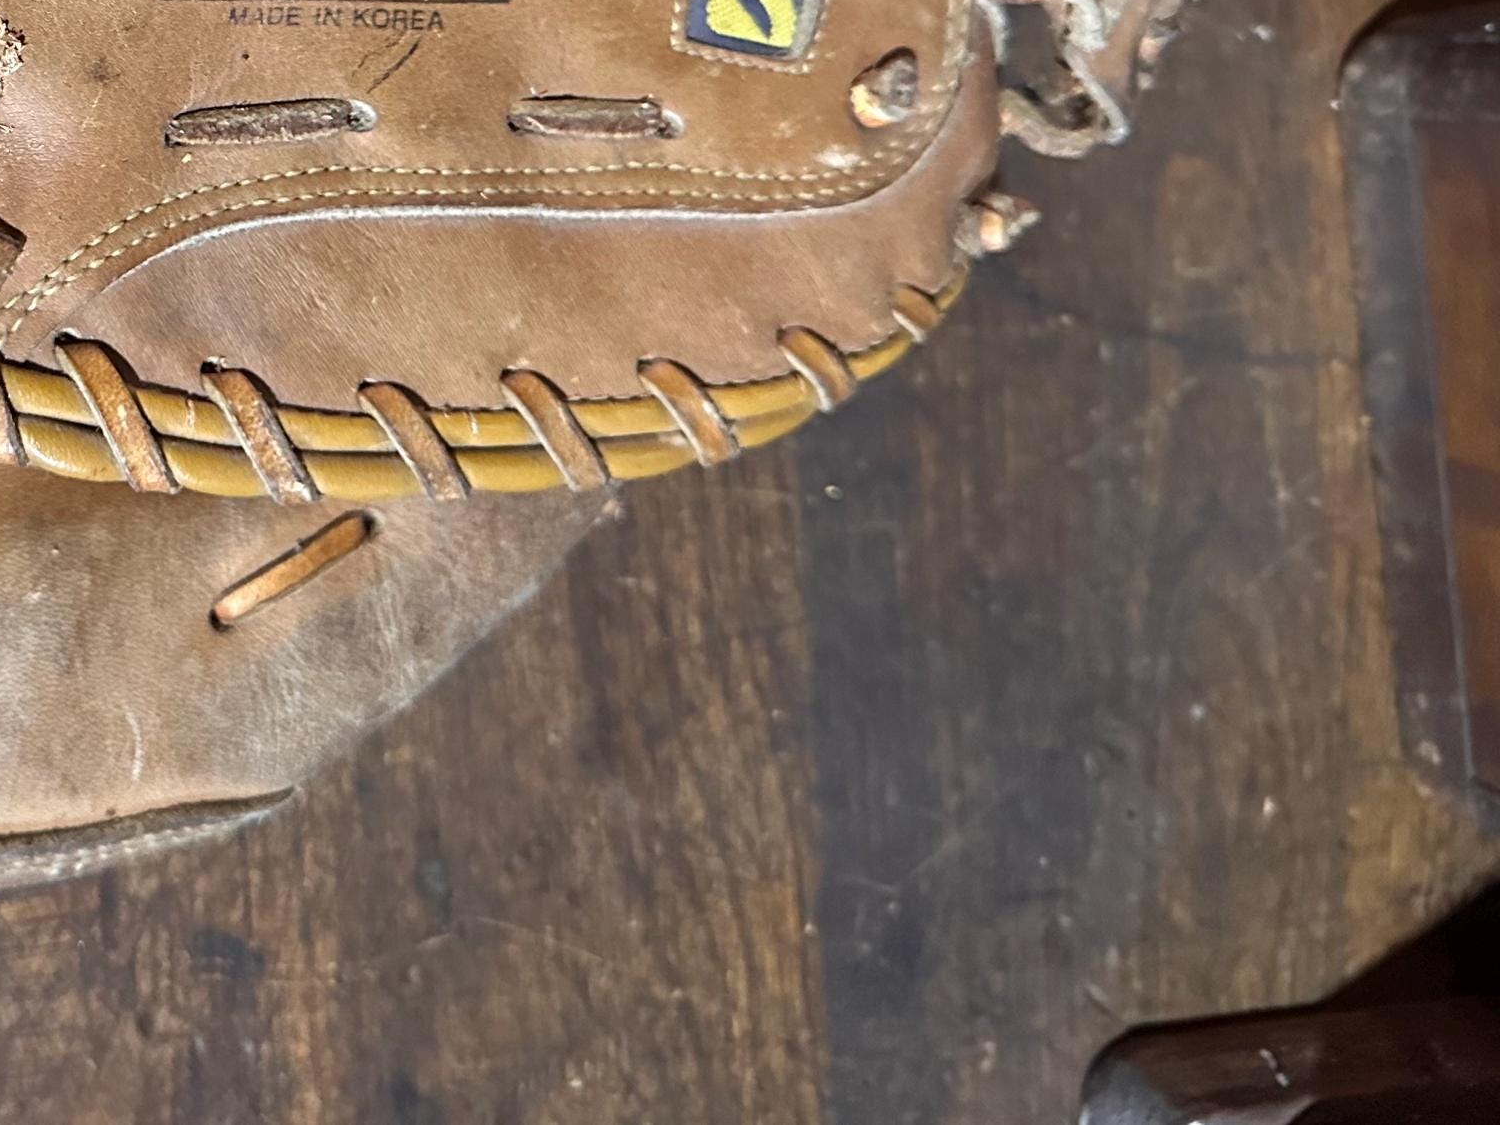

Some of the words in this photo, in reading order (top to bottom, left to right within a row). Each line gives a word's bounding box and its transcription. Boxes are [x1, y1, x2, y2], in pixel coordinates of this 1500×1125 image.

[228, 6, 301, 28] MADE
[313, 8, 344, 29] IN
[352, 8, 445, 31] KOREA
